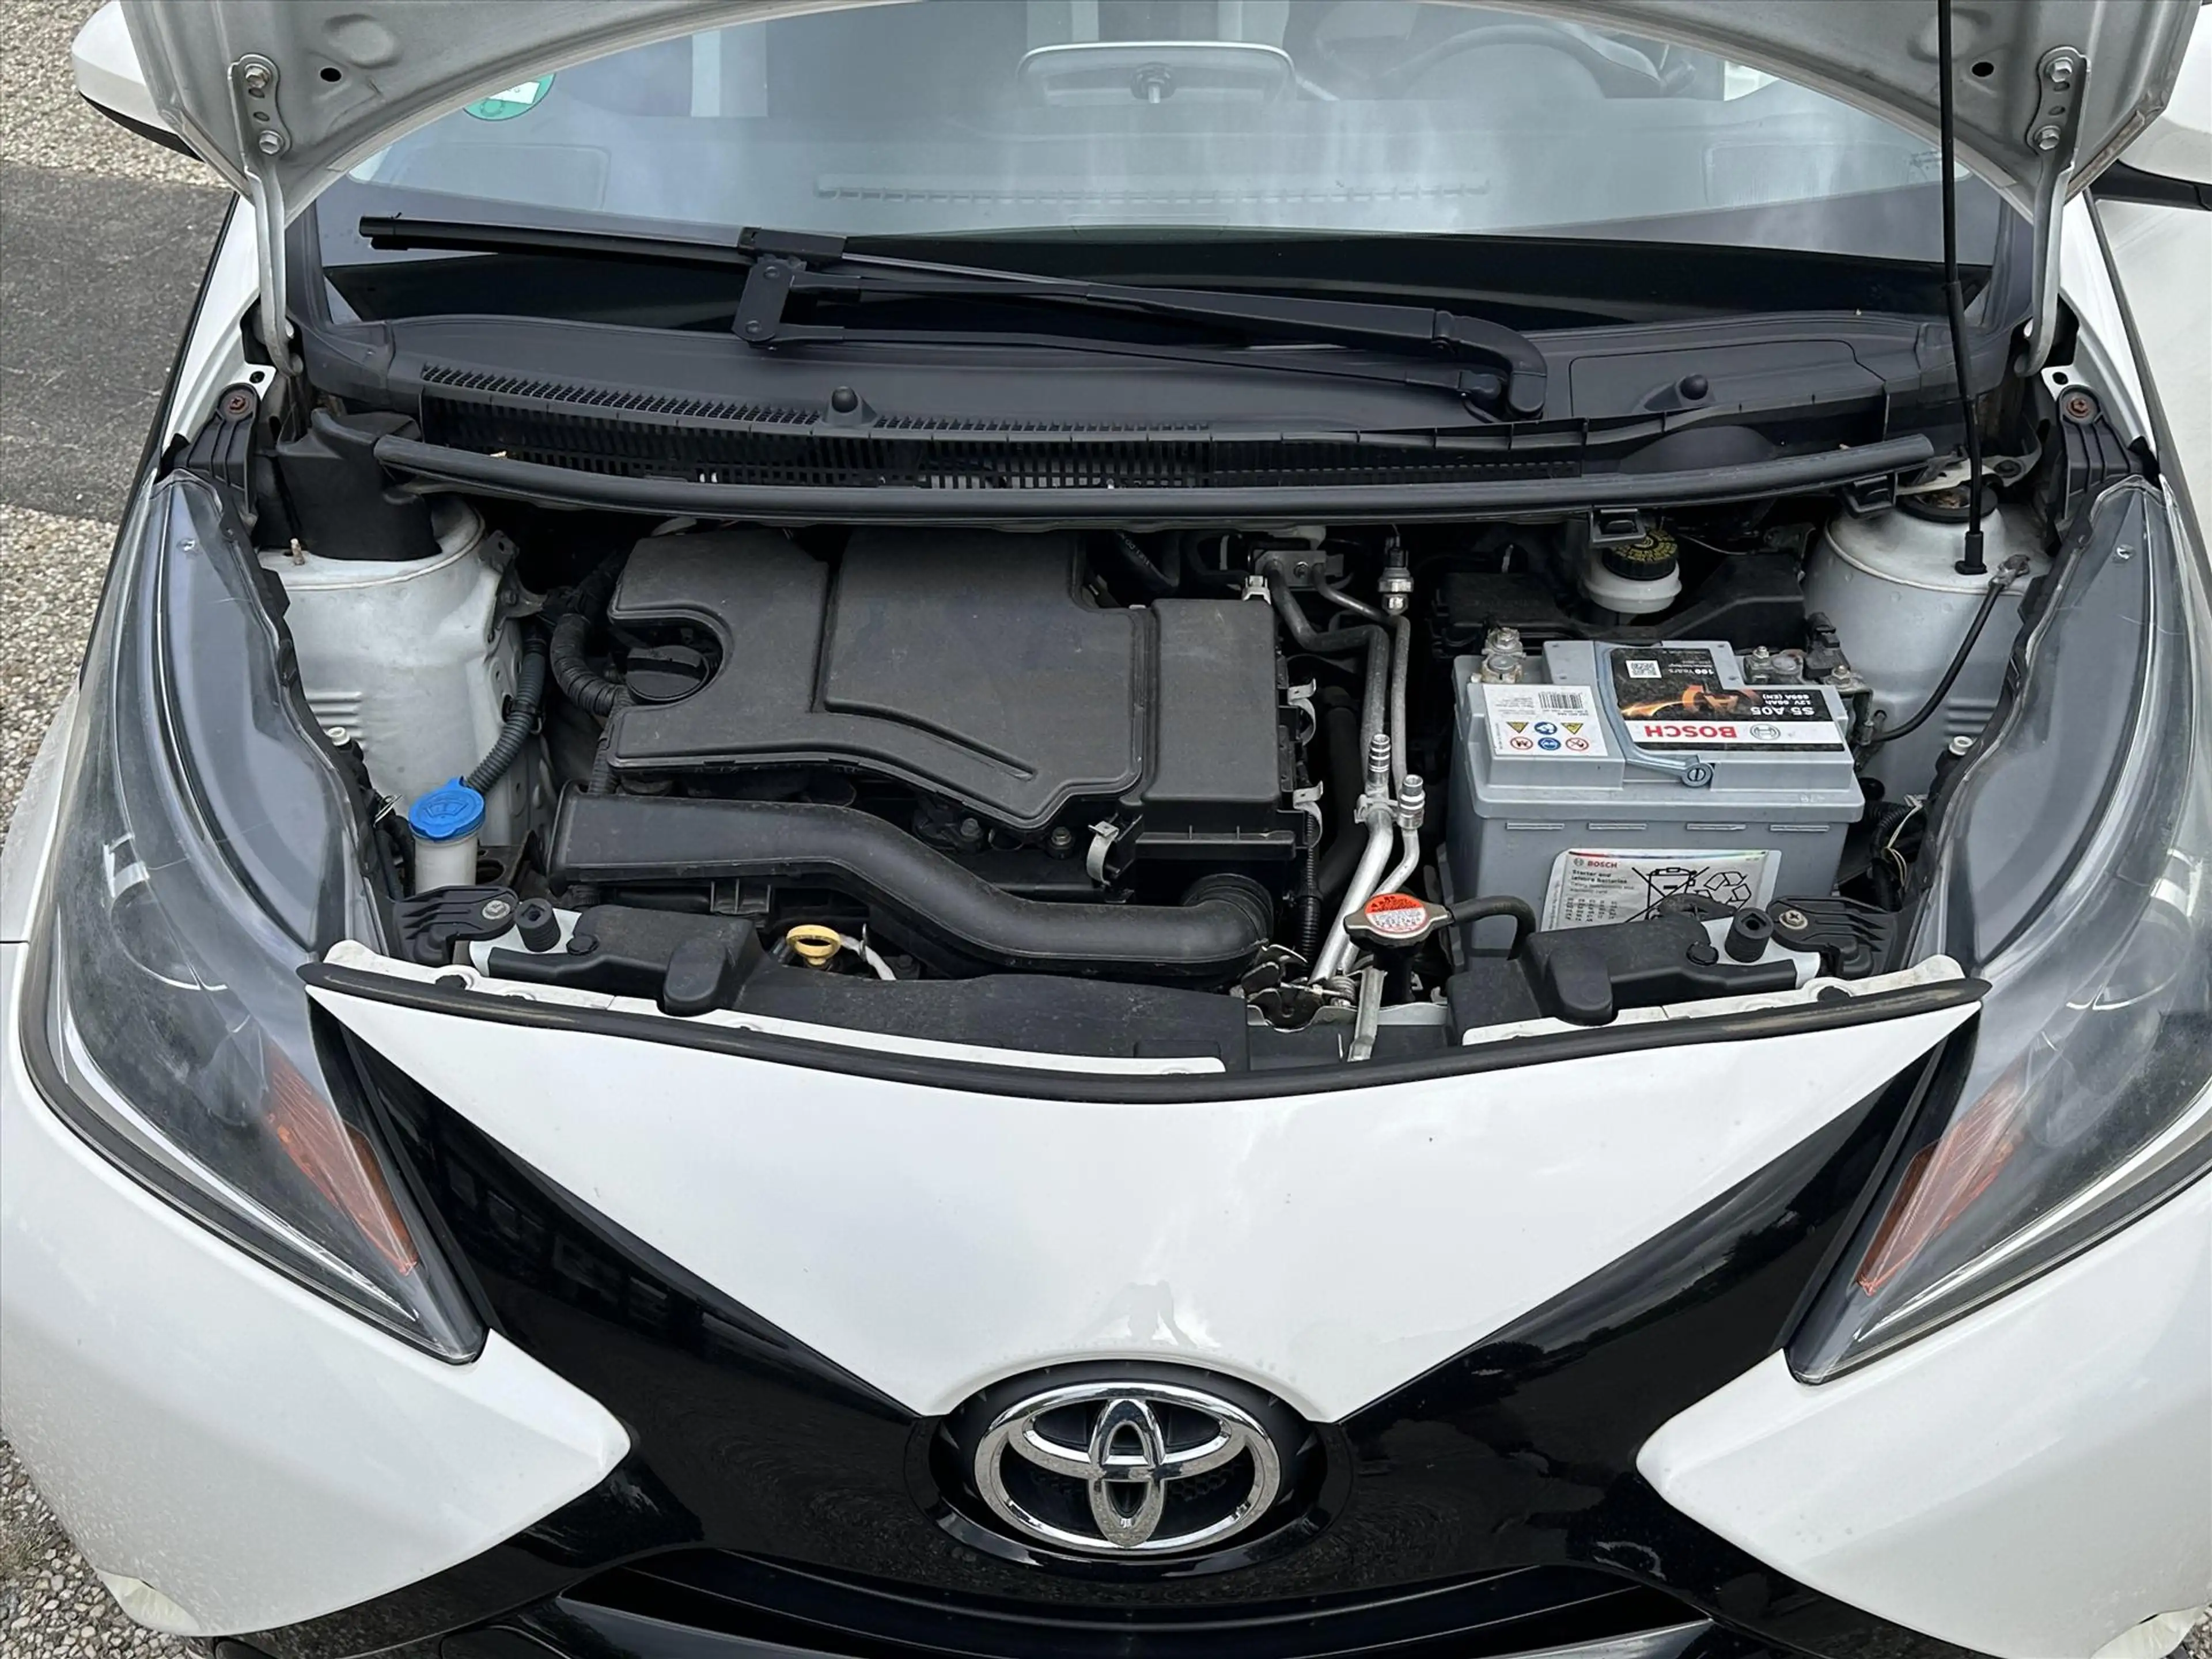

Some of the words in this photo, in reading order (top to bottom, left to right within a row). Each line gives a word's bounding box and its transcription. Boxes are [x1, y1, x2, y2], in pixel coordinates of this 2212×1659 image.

[1750, 707, 1785, 715] A05
[1791, 707, 1815, 715] S5
[1644, 725, 1737, 738] BOSCH
